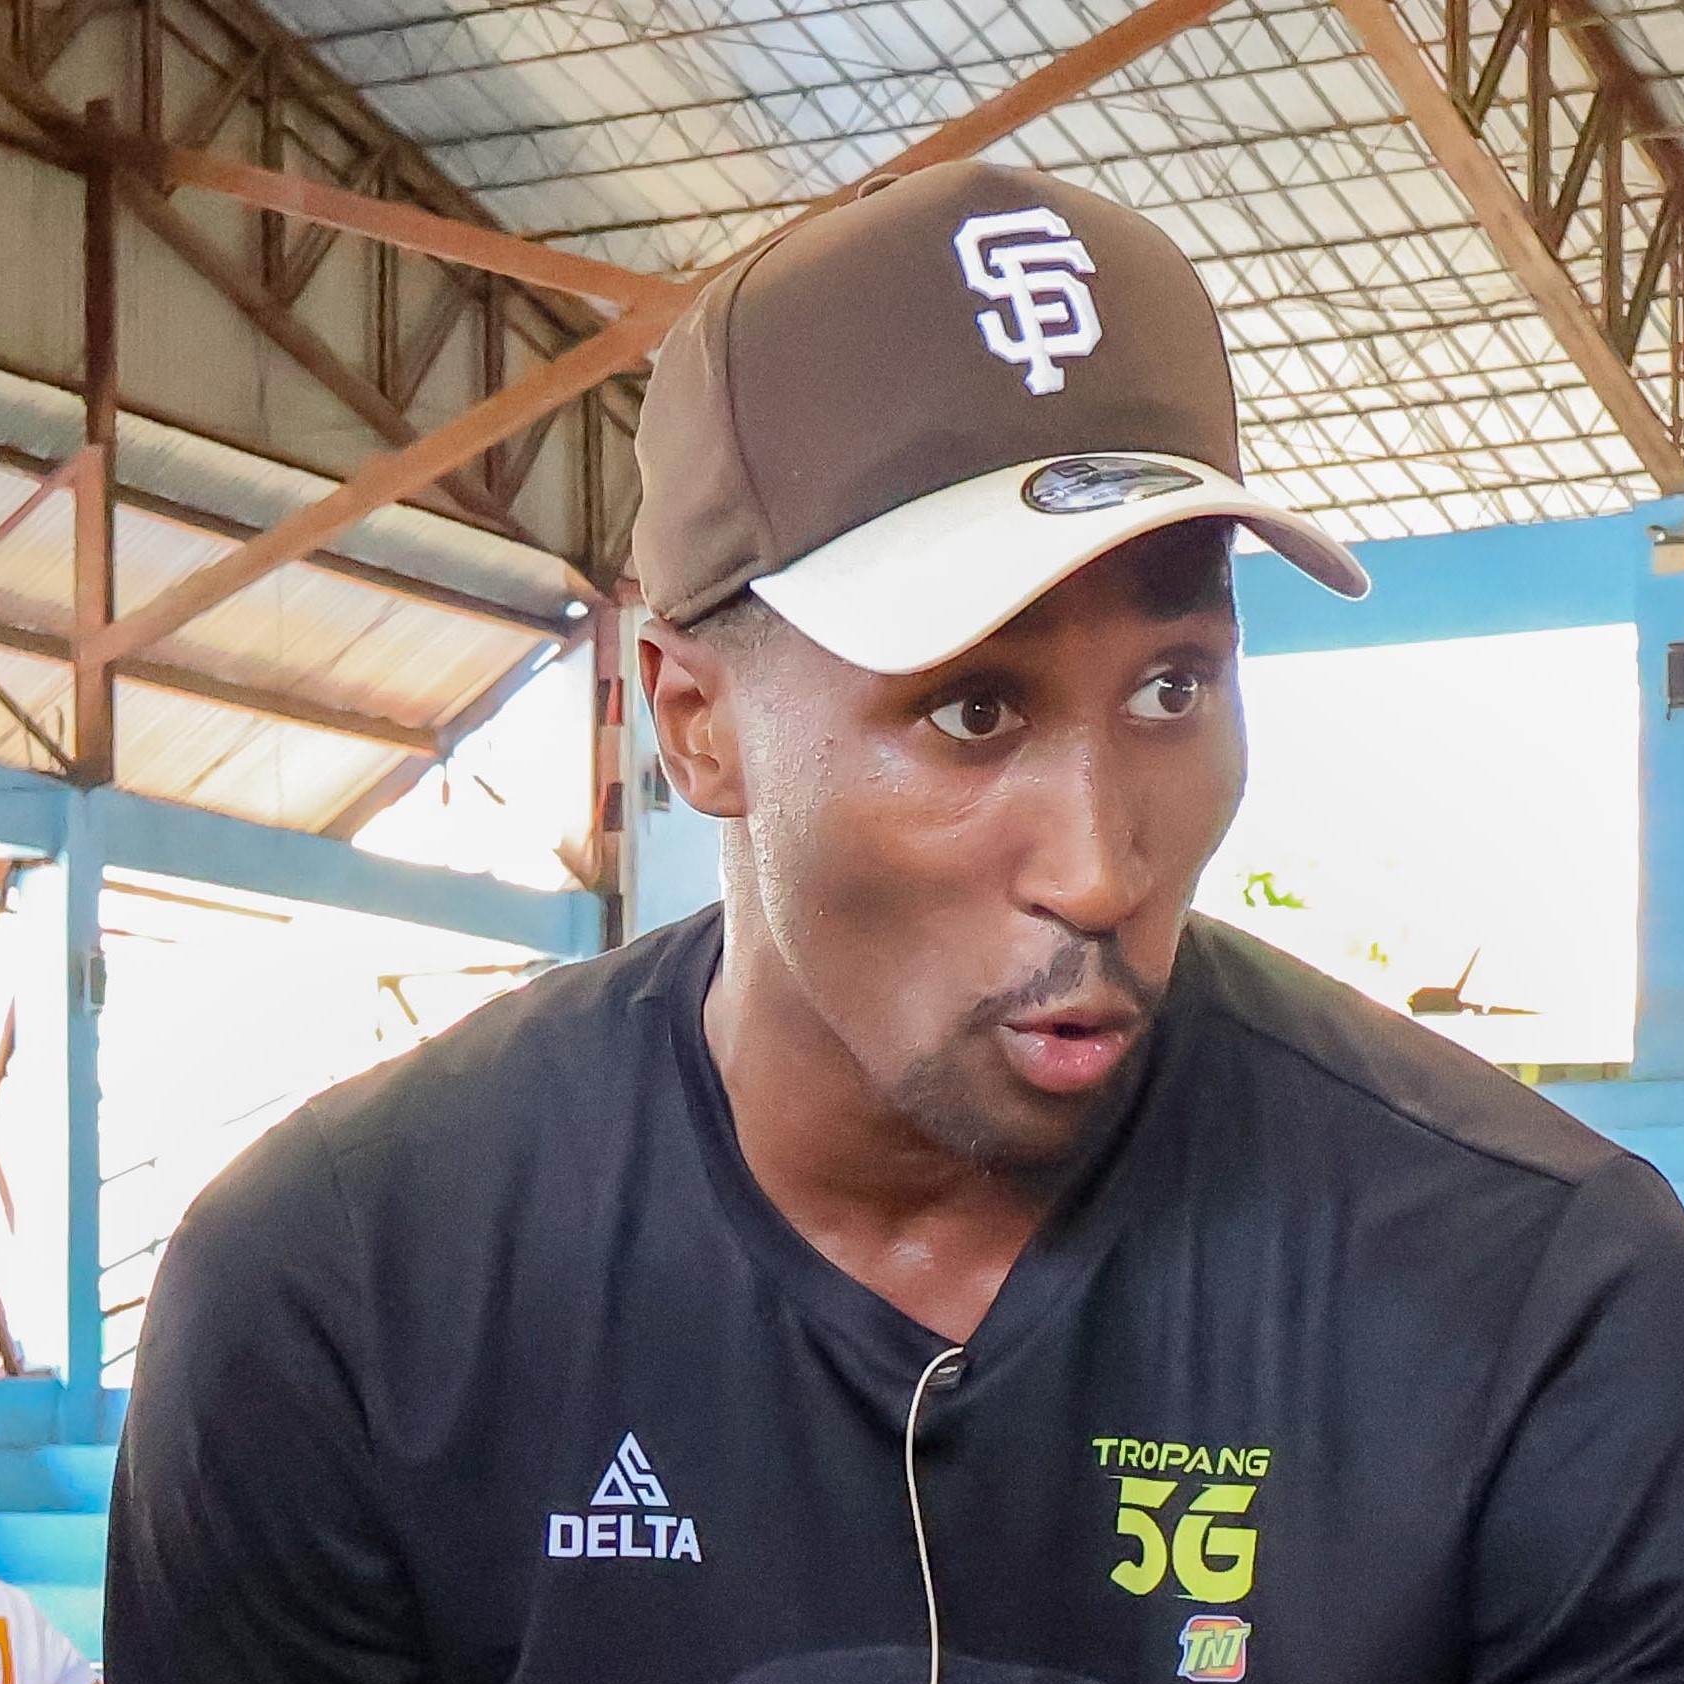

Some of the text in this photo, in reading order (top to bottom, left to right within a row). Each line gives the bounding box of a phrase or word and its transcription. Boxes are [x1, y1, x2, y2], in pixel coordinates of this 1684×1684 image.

[953, 206, 1103, 396] SF
[1092, 1438, 1270, 1477] TROPANG
[548, 1513, 702, 1563] DELTA
[1110, 1476, 1258, 1603] 5G
[1182, 1625, 1251, 1673] TNT
